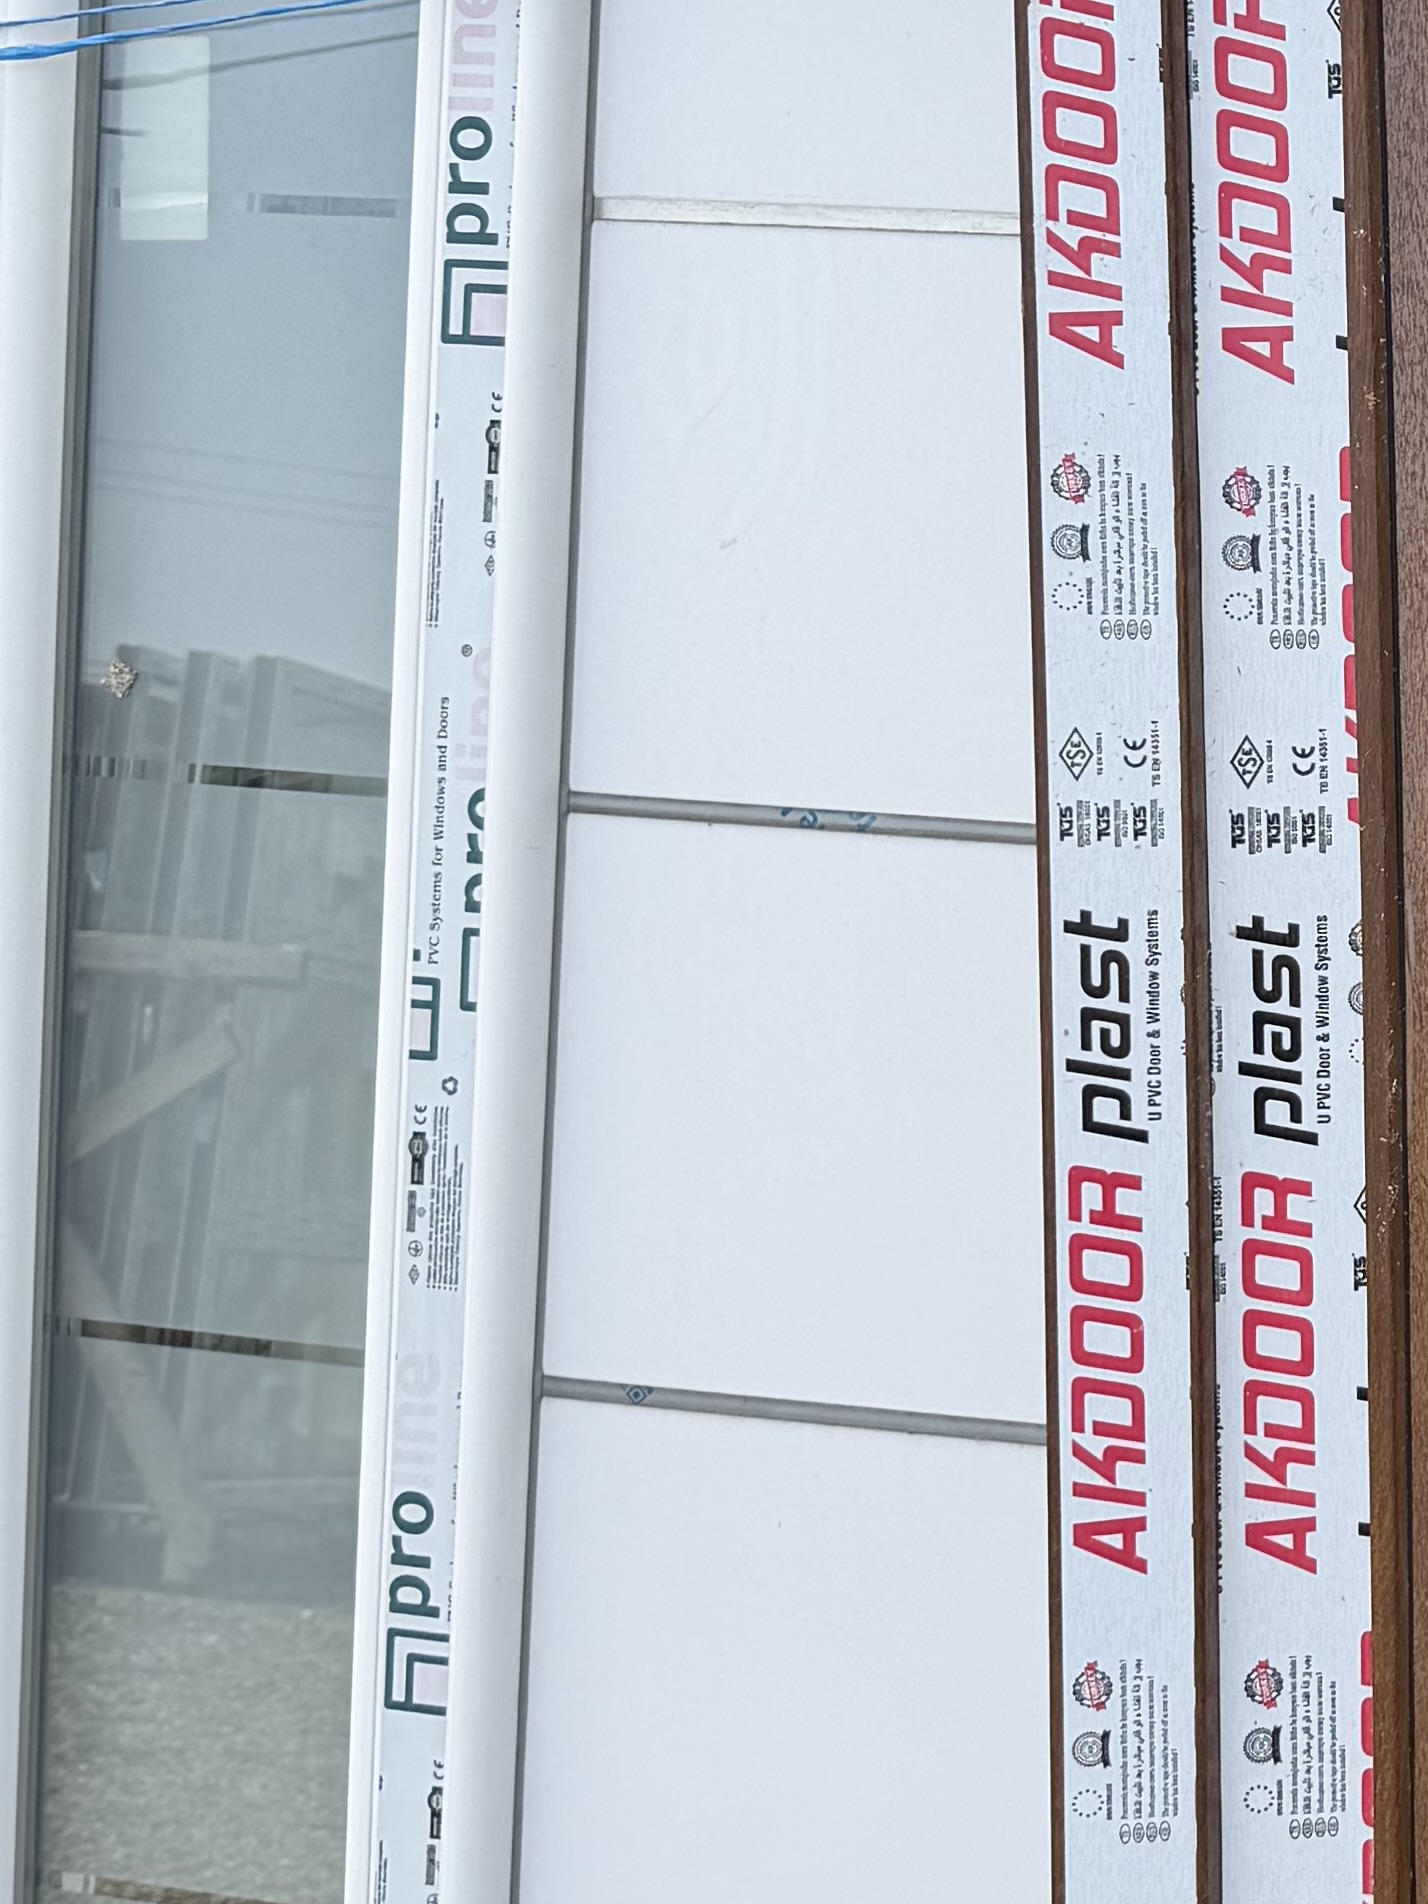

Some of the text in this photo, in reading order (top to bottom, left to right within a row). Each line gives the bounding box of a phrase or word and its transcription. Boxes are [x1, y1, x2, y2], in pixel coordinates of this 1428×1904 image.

[1238, 747, 1256, 775] TSE
[1292, 746, 1315, 776] CE
[1234, 914, 1322, 1147] plast
[1314, 915, 1332, 1124] U PVC Door & Window Systems
[1063, 909, 1151, 1574] AKDOOR plast
[1239, 1171, 1317, 1574] AKDOOR
